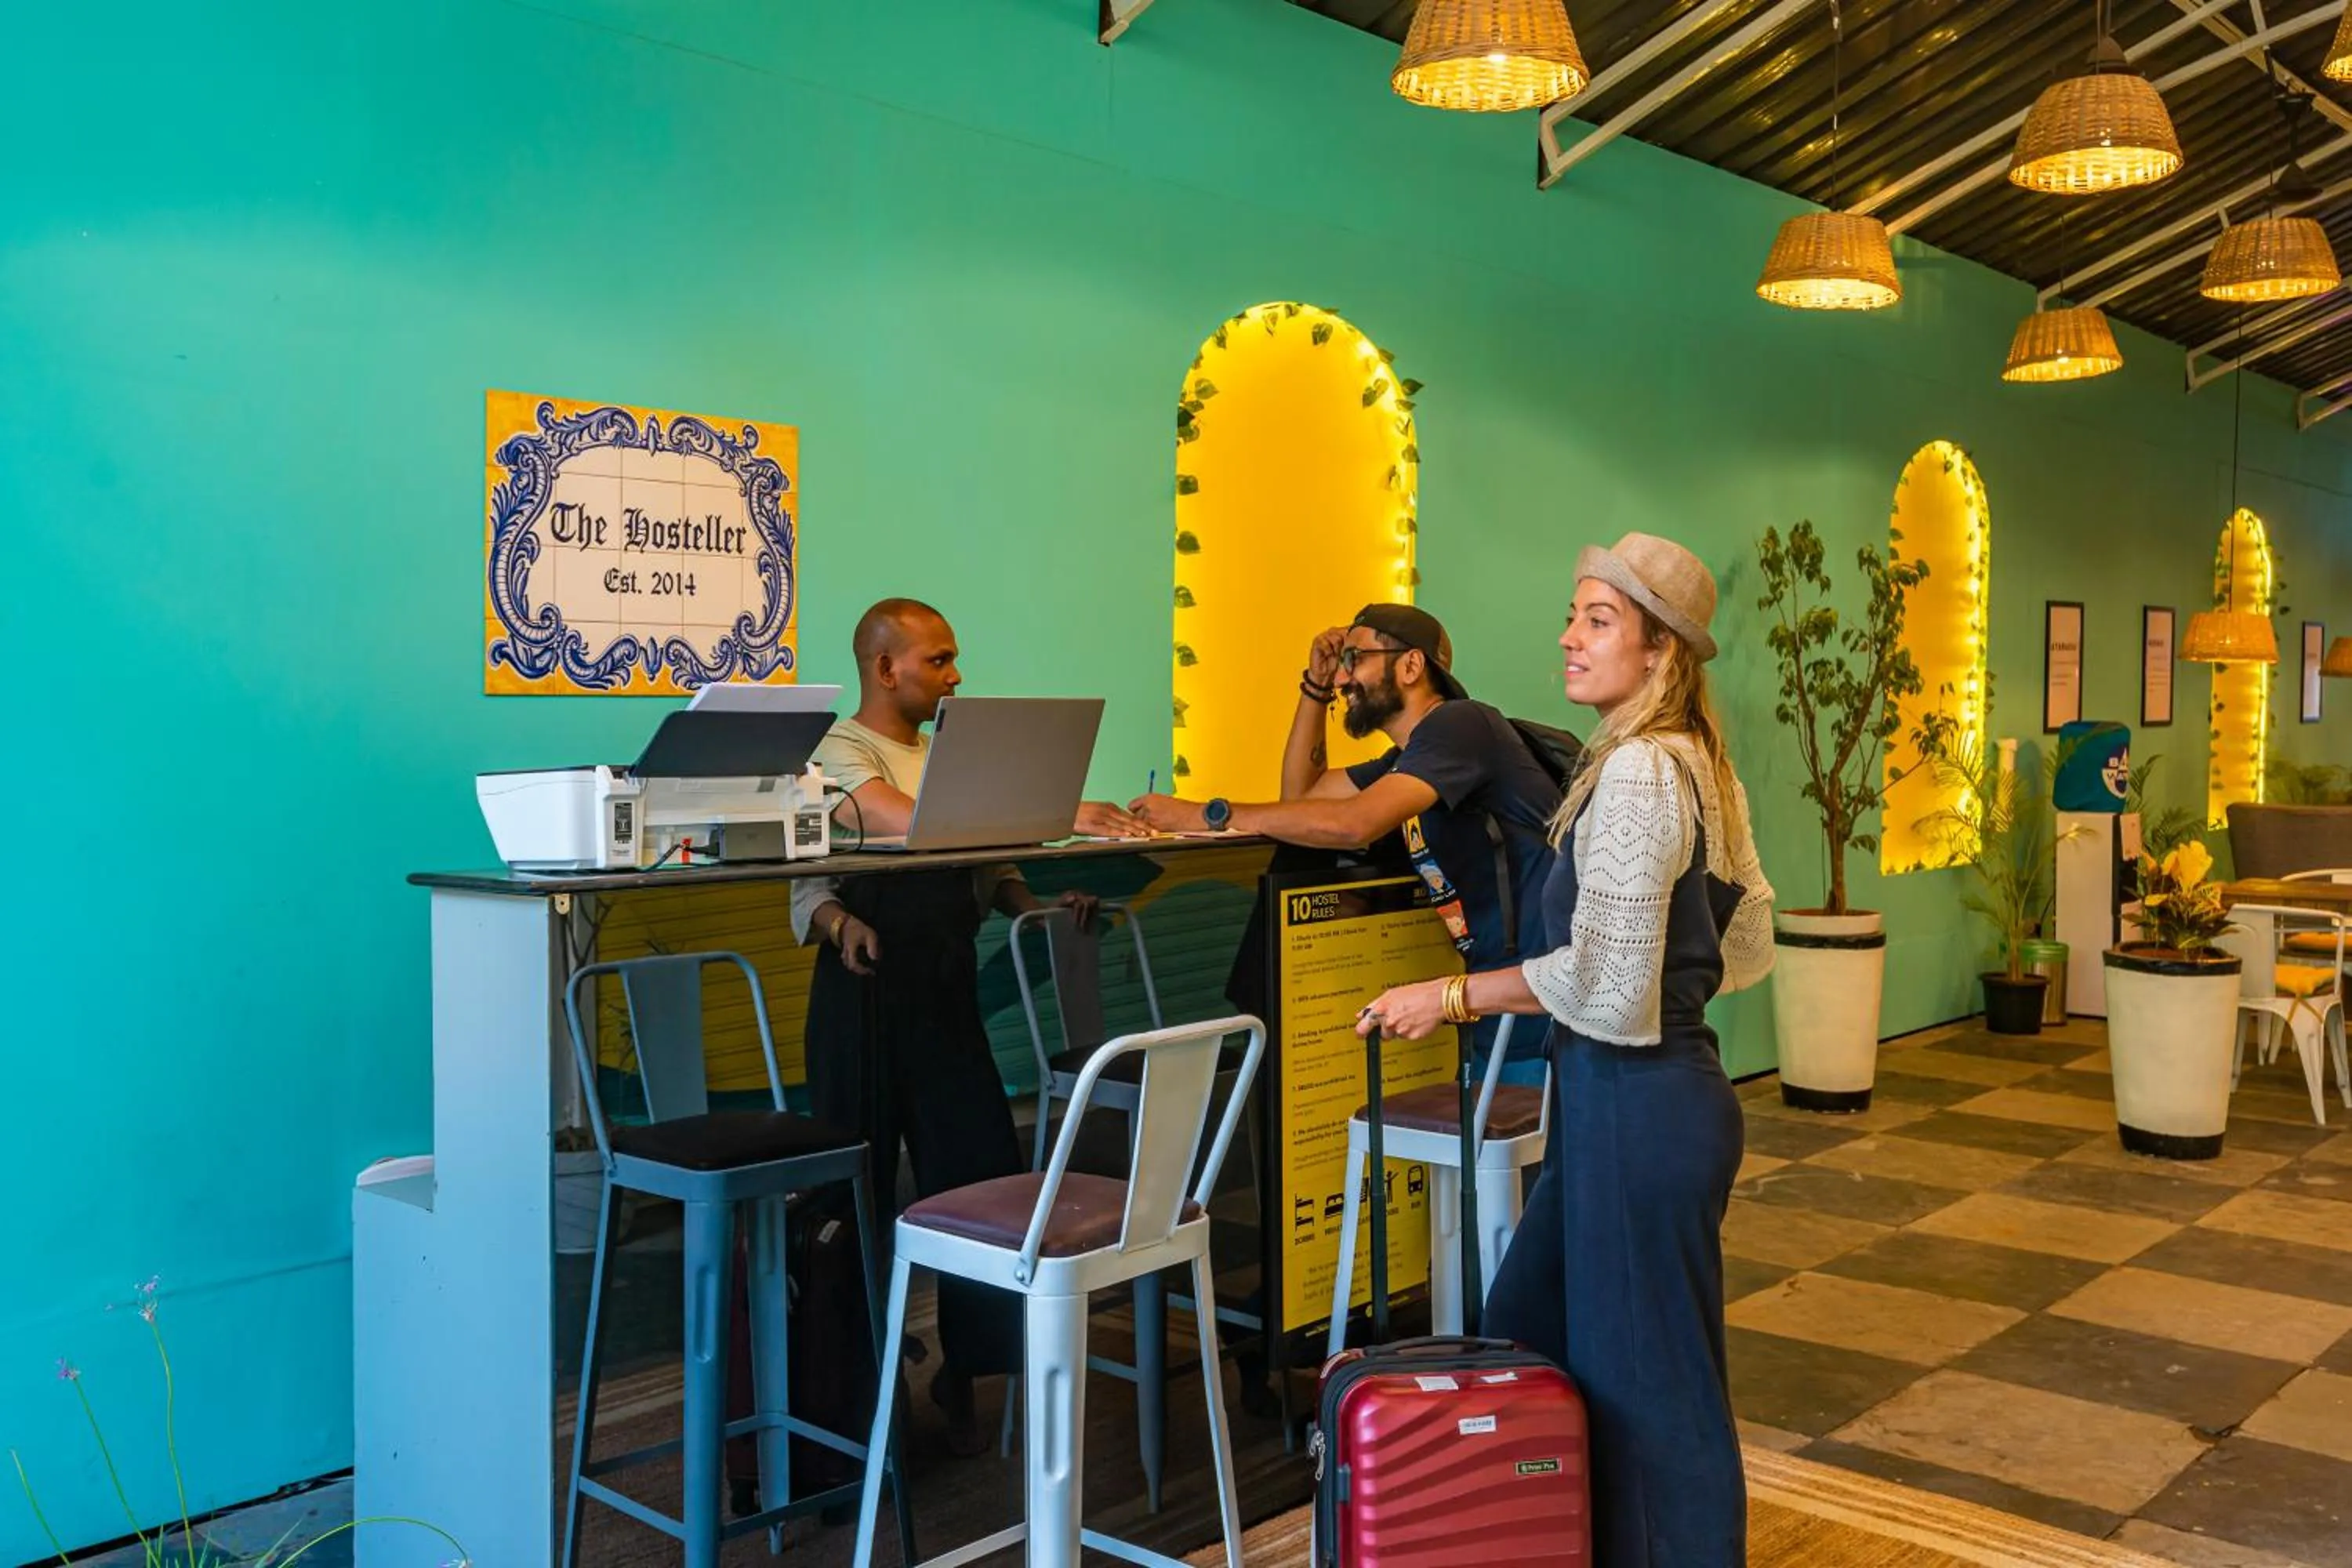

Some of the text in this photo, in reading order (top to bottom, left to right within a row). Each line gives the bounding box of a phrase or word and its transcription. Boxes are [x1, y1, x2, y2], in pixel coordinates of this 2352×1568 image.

[550, 503, 747, 554] The Hosteller
[604, 568, 697, 596] Est. 2014
[1291, 896, 1312, 921] 10
[1312, 893, 1340, 906] HOSTEL
[1312, 906, 1335, 920] RULES
